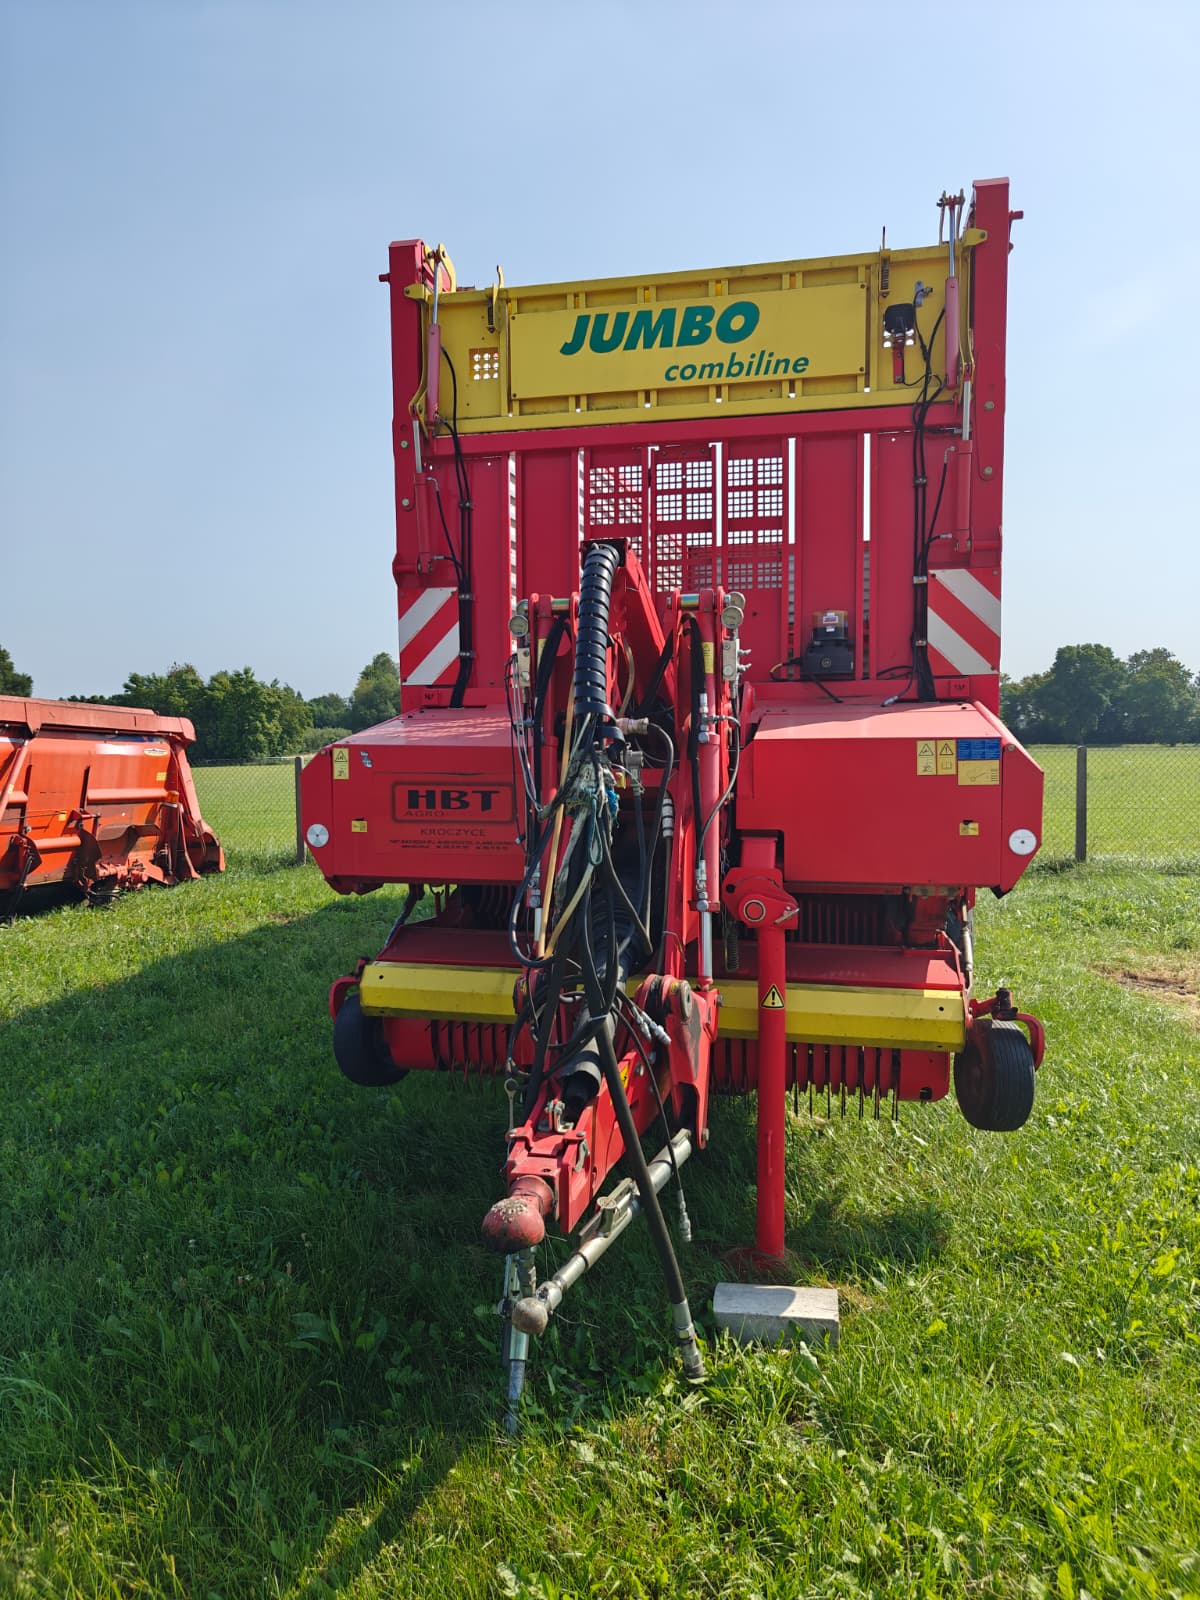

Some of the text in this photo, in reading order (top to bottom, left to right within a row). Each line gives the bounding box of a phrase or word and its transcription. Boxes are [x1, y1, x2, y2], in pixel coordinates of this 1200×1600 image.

[559, 301, 760, 356] JUMBO
[664, 350, 809, 382] combiline
[407, 789, 501, 812] HBT
[420, 827, 487, 837] KROCZYCE
